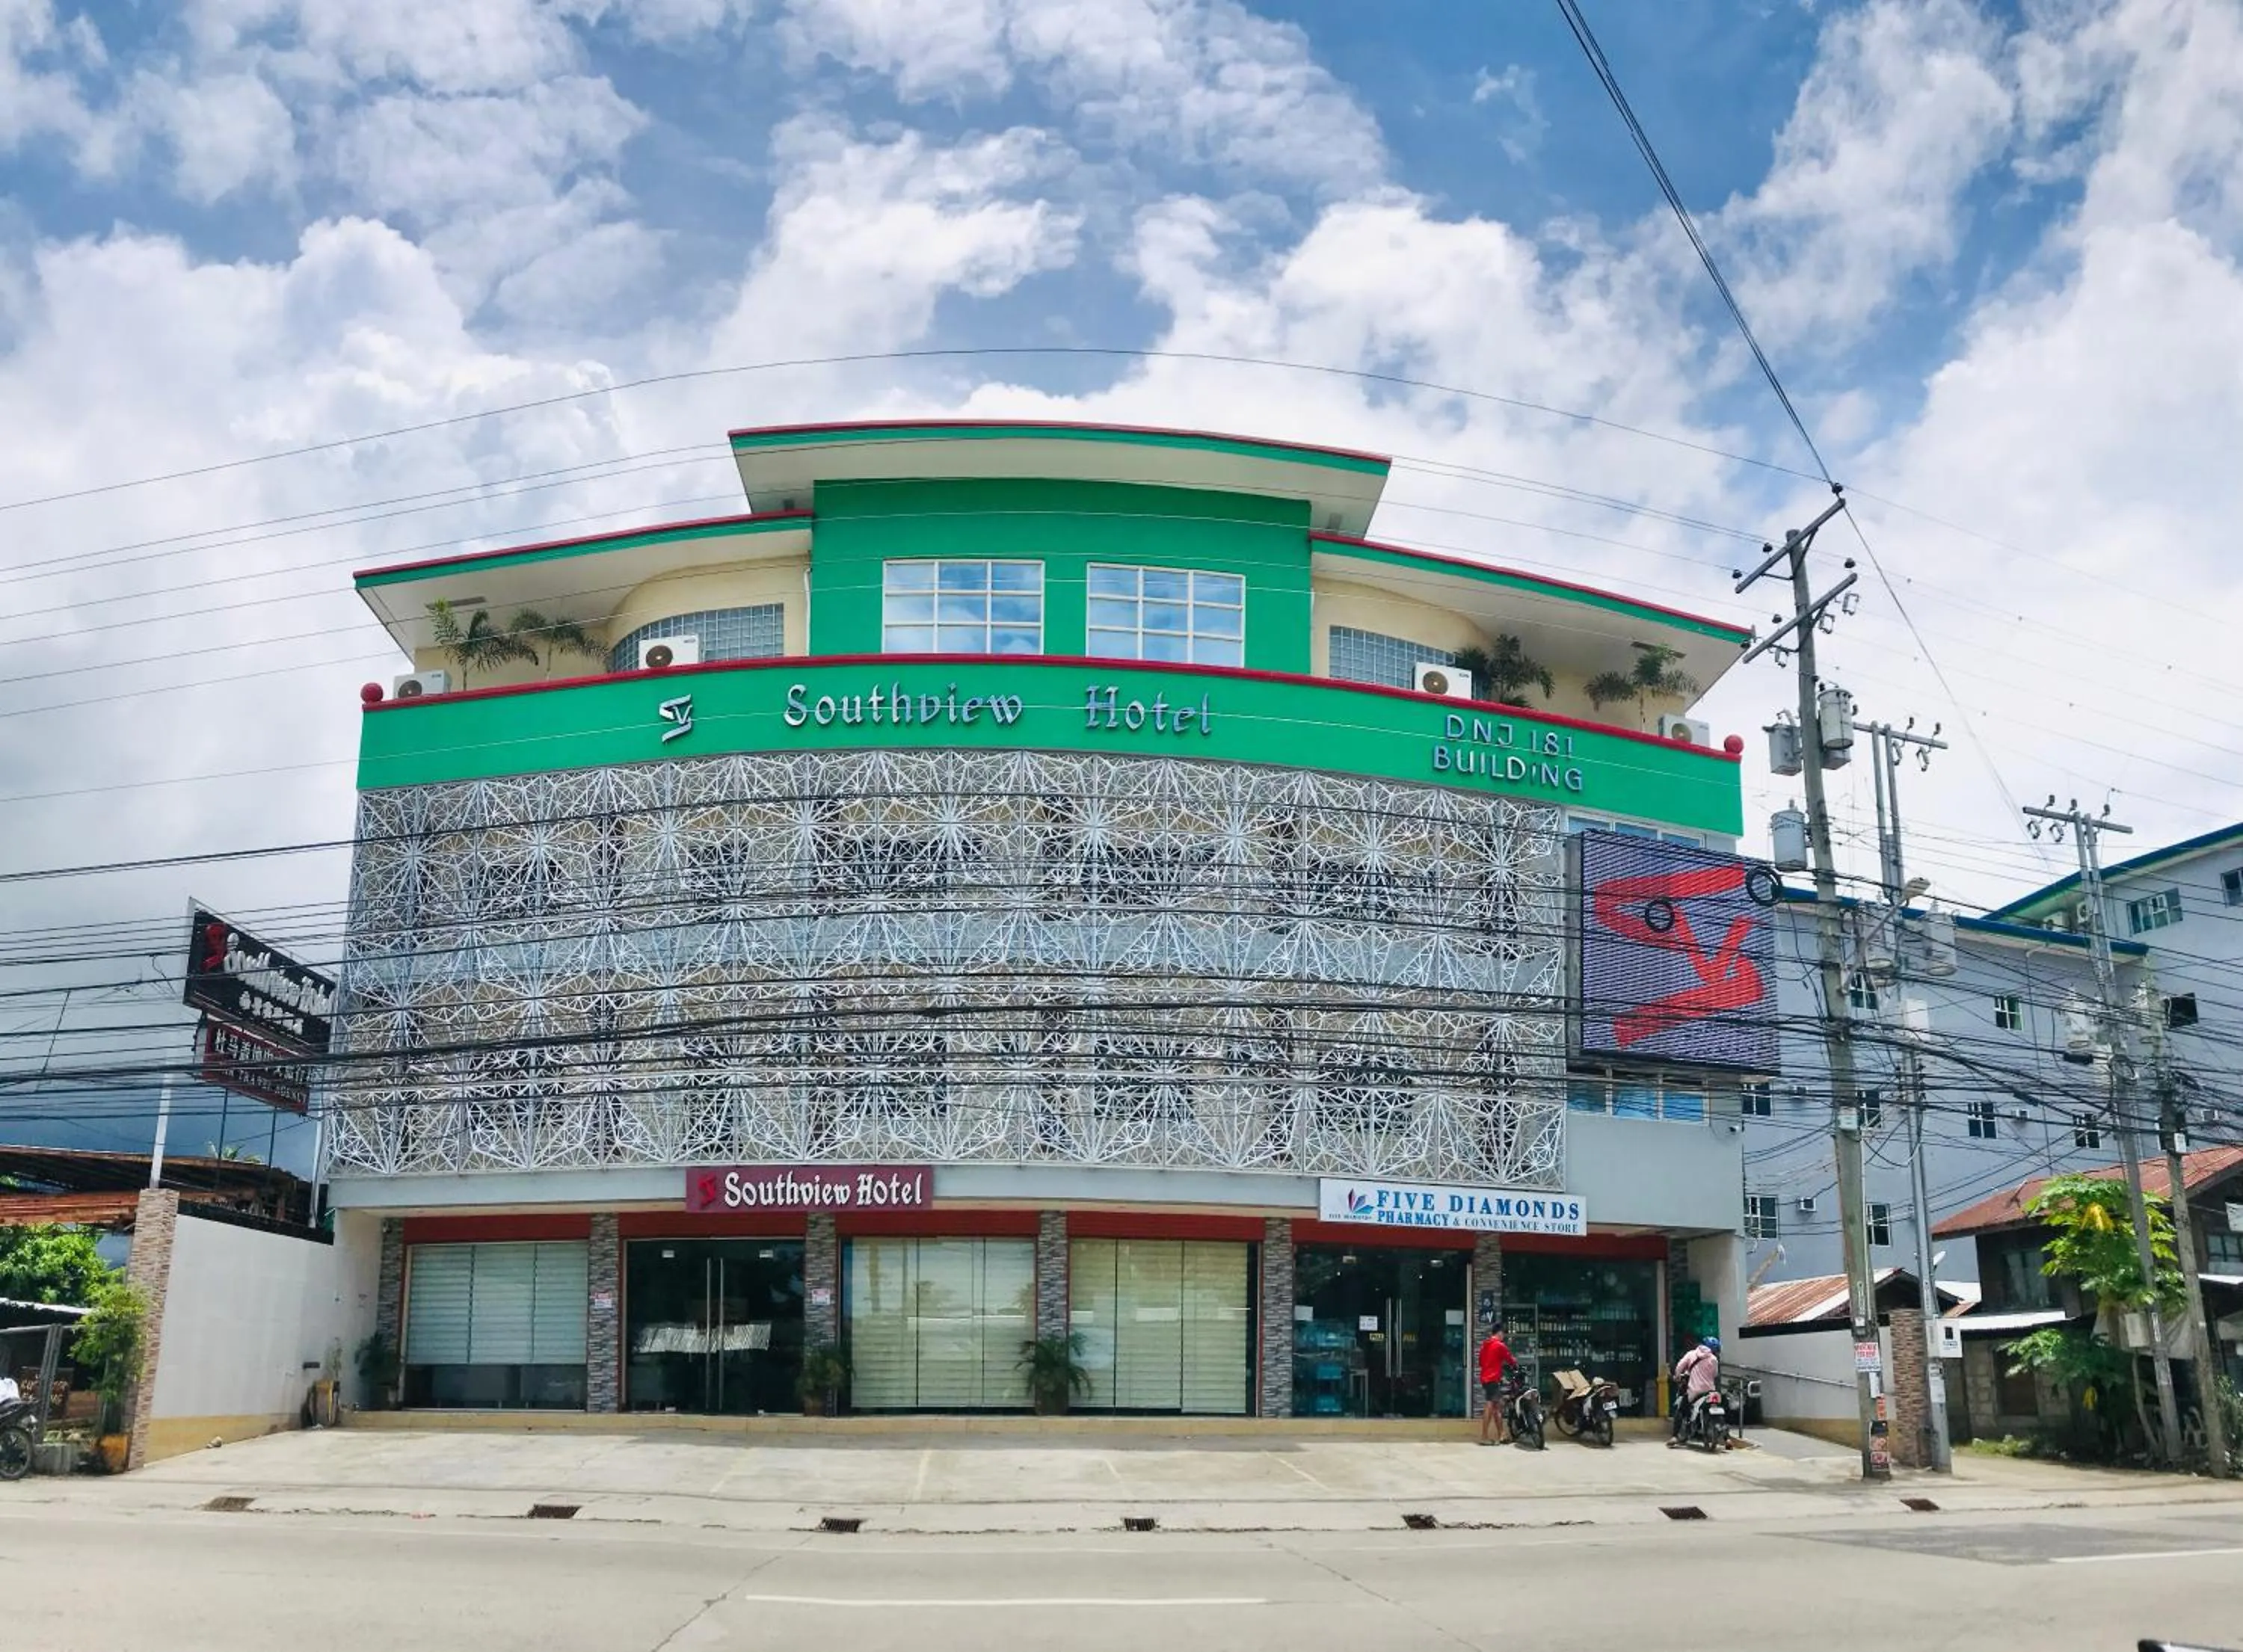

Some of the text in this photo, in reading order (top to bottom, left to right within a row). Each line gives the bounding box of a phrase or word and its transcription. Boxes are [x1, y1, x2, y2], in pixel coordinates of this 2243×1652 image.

[783, 682, 1210, 735] Southview Hotel
[1446, 713, 1513, 747] DNJ
[724, 1170, 923, 1209] Southview Hotel
[1376, 1190, 1580, 1221] FIVE DIAMONDS
[1377, 1210, 1449, 1227] PHARMACY
[1453, 1216, 1459, 1227] &
[1544, 1222, 1579, 1233] STORE
